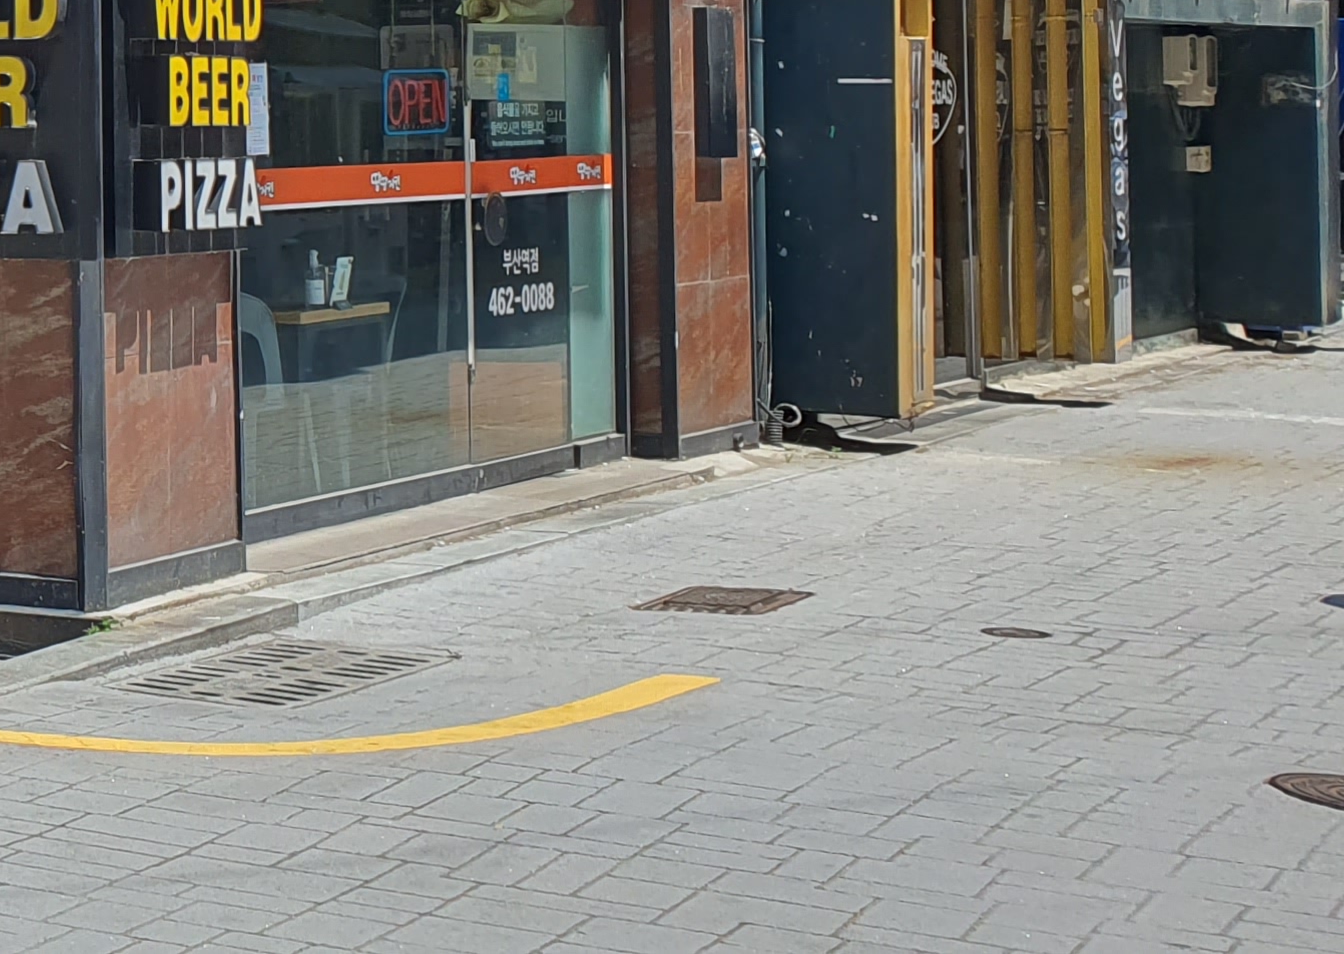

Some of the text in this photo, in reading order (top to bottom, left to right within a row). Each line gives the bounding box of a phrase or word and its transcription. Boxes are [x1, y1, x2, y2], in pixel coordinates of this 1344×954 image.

[168, 56, 252, 127] BEER
[388, 79, 448, 126] OPEN
[161, 157, 263, 233] PIZZA
[502, 247, 539, 275] 부산역점
[488, 282, 555, 317] 462-0088
